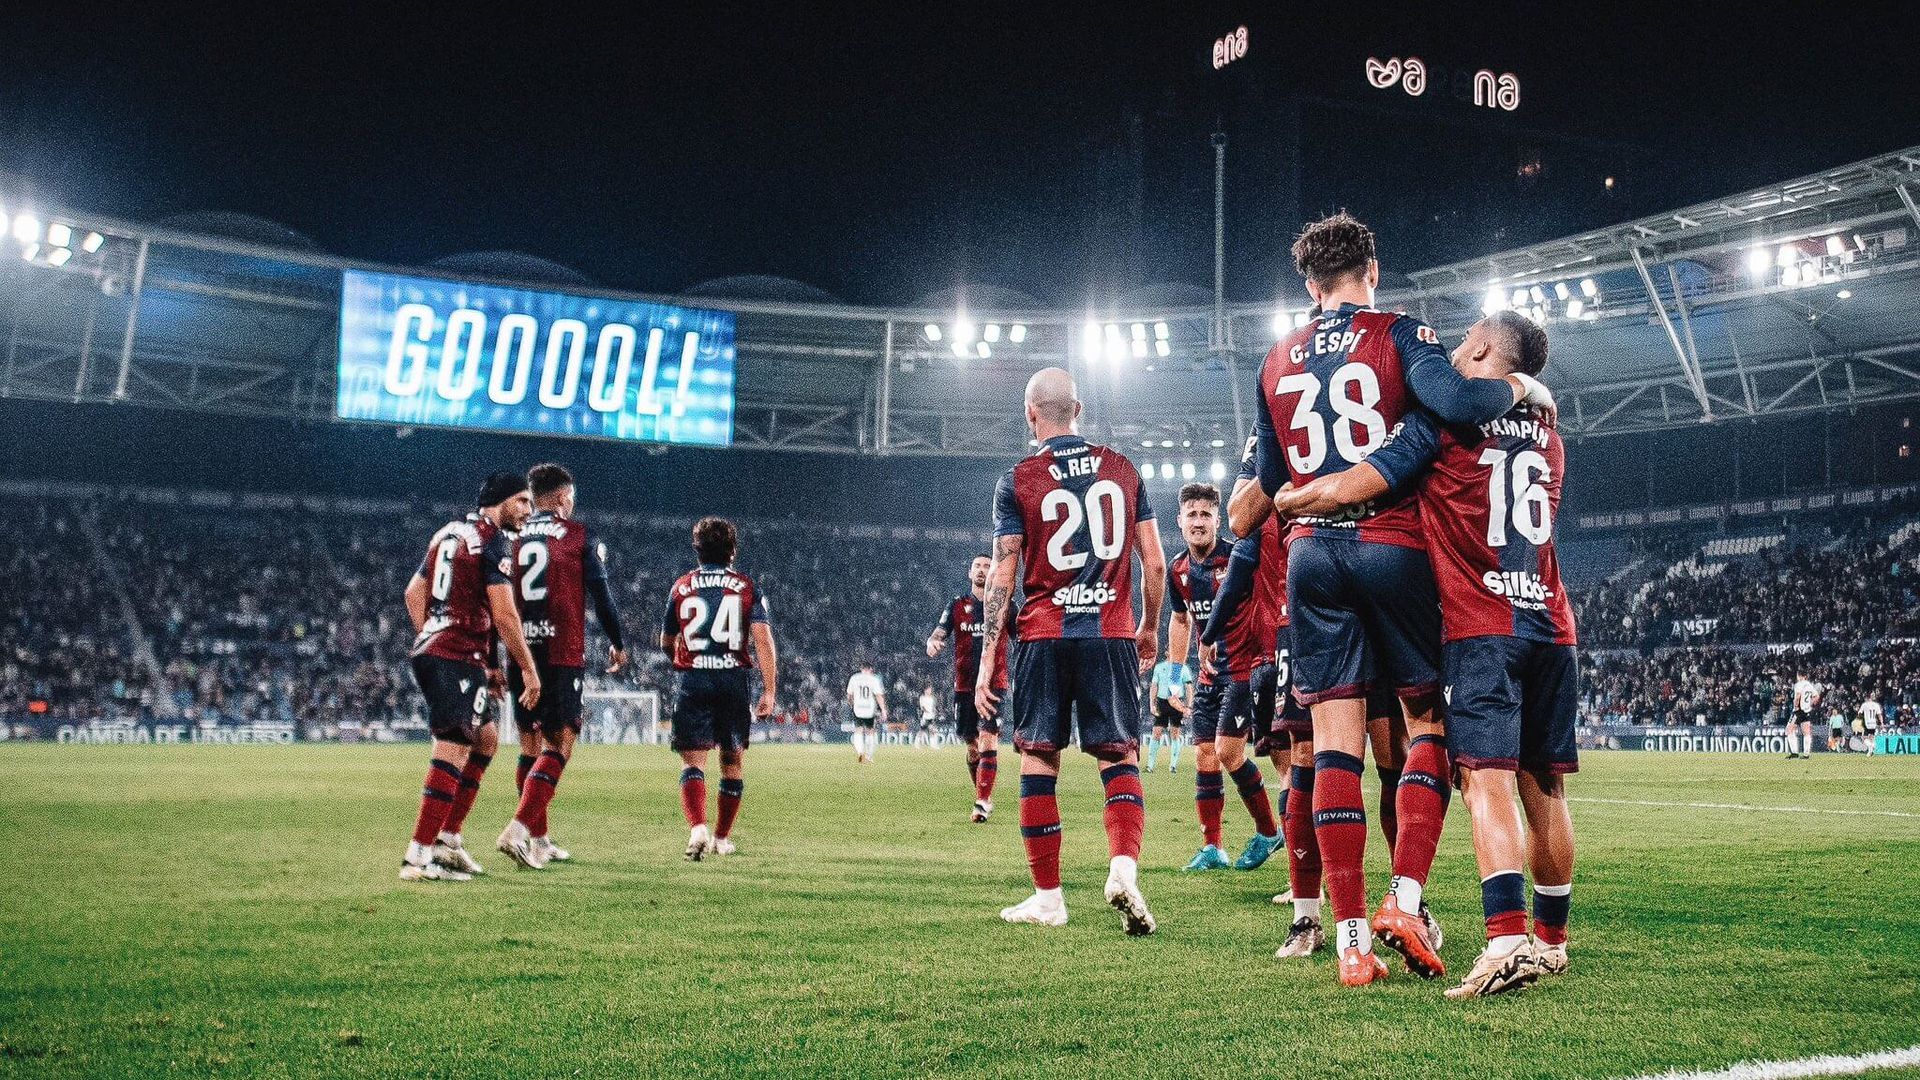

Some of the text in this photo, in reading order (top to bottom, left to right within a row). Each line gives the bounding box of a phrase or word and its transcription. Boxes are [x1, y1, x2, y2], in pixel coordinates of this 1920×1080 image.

[1315, 328, 1368, 354] ESPÍ
[385, 303, 700, 418] GOOOOL!
[1275, 362, 1387, 475] 38
[1048, 456, 1102, 481] O. REY
[1477, 448, 1551, 547] 16
[1041, 480, 1125, 572] 20
[431, 538, 458, 601] 6
[518, 541, 548, 601] 2
[1064, 605, 1099, 614] Telecom
[1507, 597, 1548, 610] Telecom
[680, 594, 741, 652] 24
[473, 686, 487, 715] 6
[859, 685, 870, 699] 10
[155, 724, 189, 745] DE
[1318, 812, 1362, 822] LEVANTE
